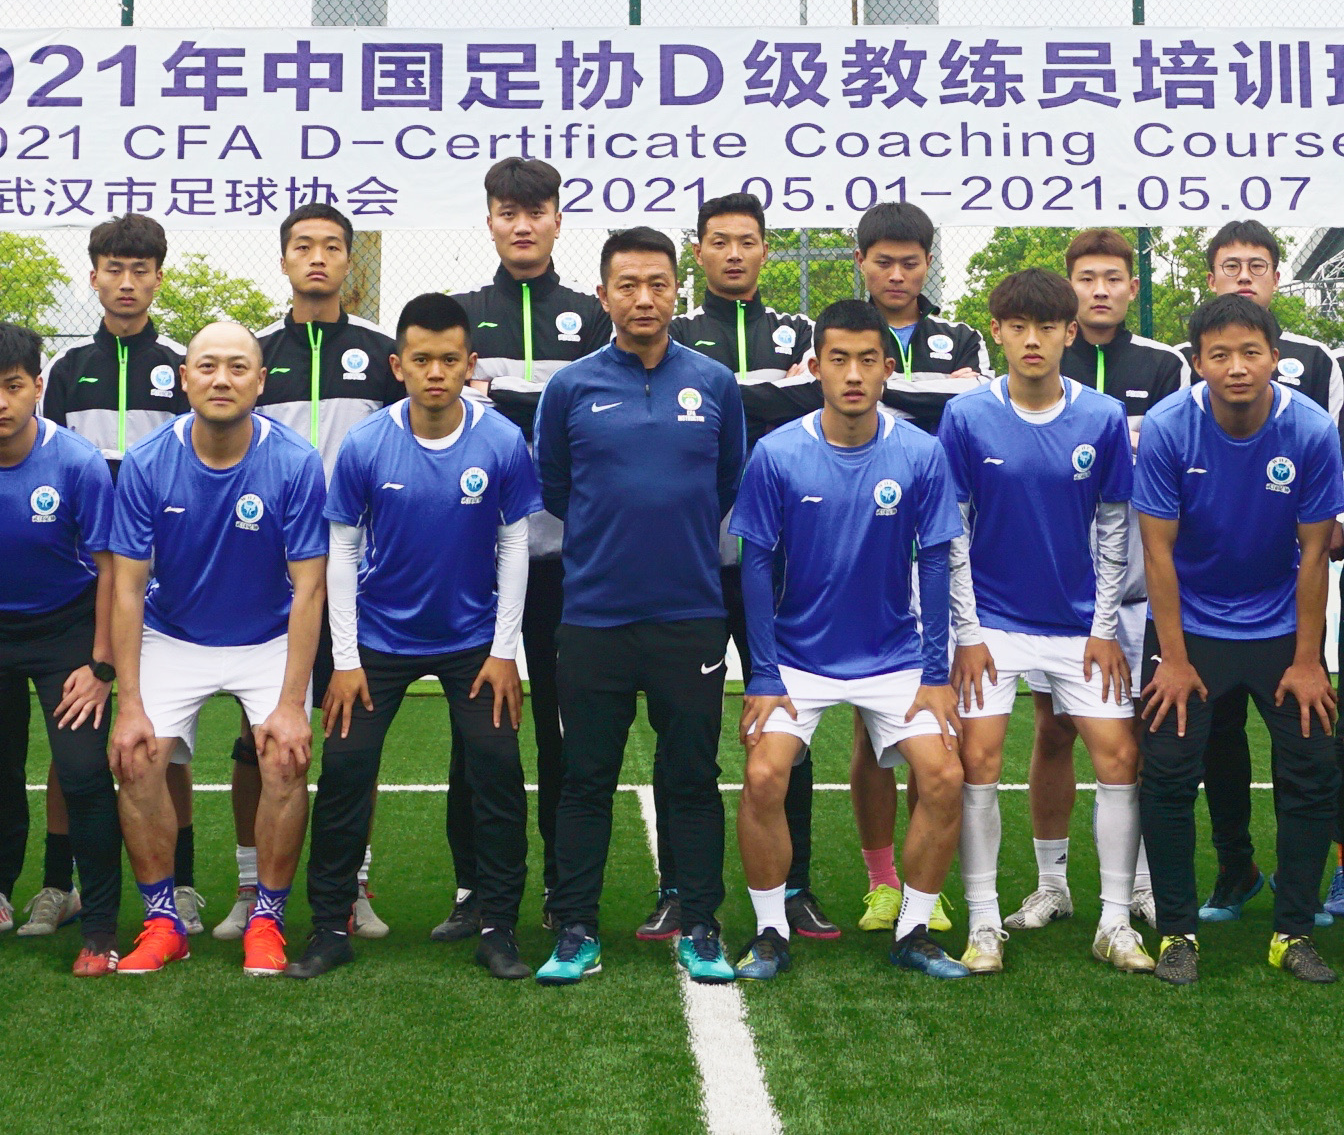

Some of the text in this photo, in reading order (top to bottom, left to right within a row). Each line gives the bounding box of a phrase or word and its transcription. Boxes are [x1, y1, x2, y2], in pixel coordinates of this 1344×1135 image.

[123, 125, 263, 160] CFA
[300, 123, 748, 161] D-Certificate
[784, 122, 1095, 166] Coaching
